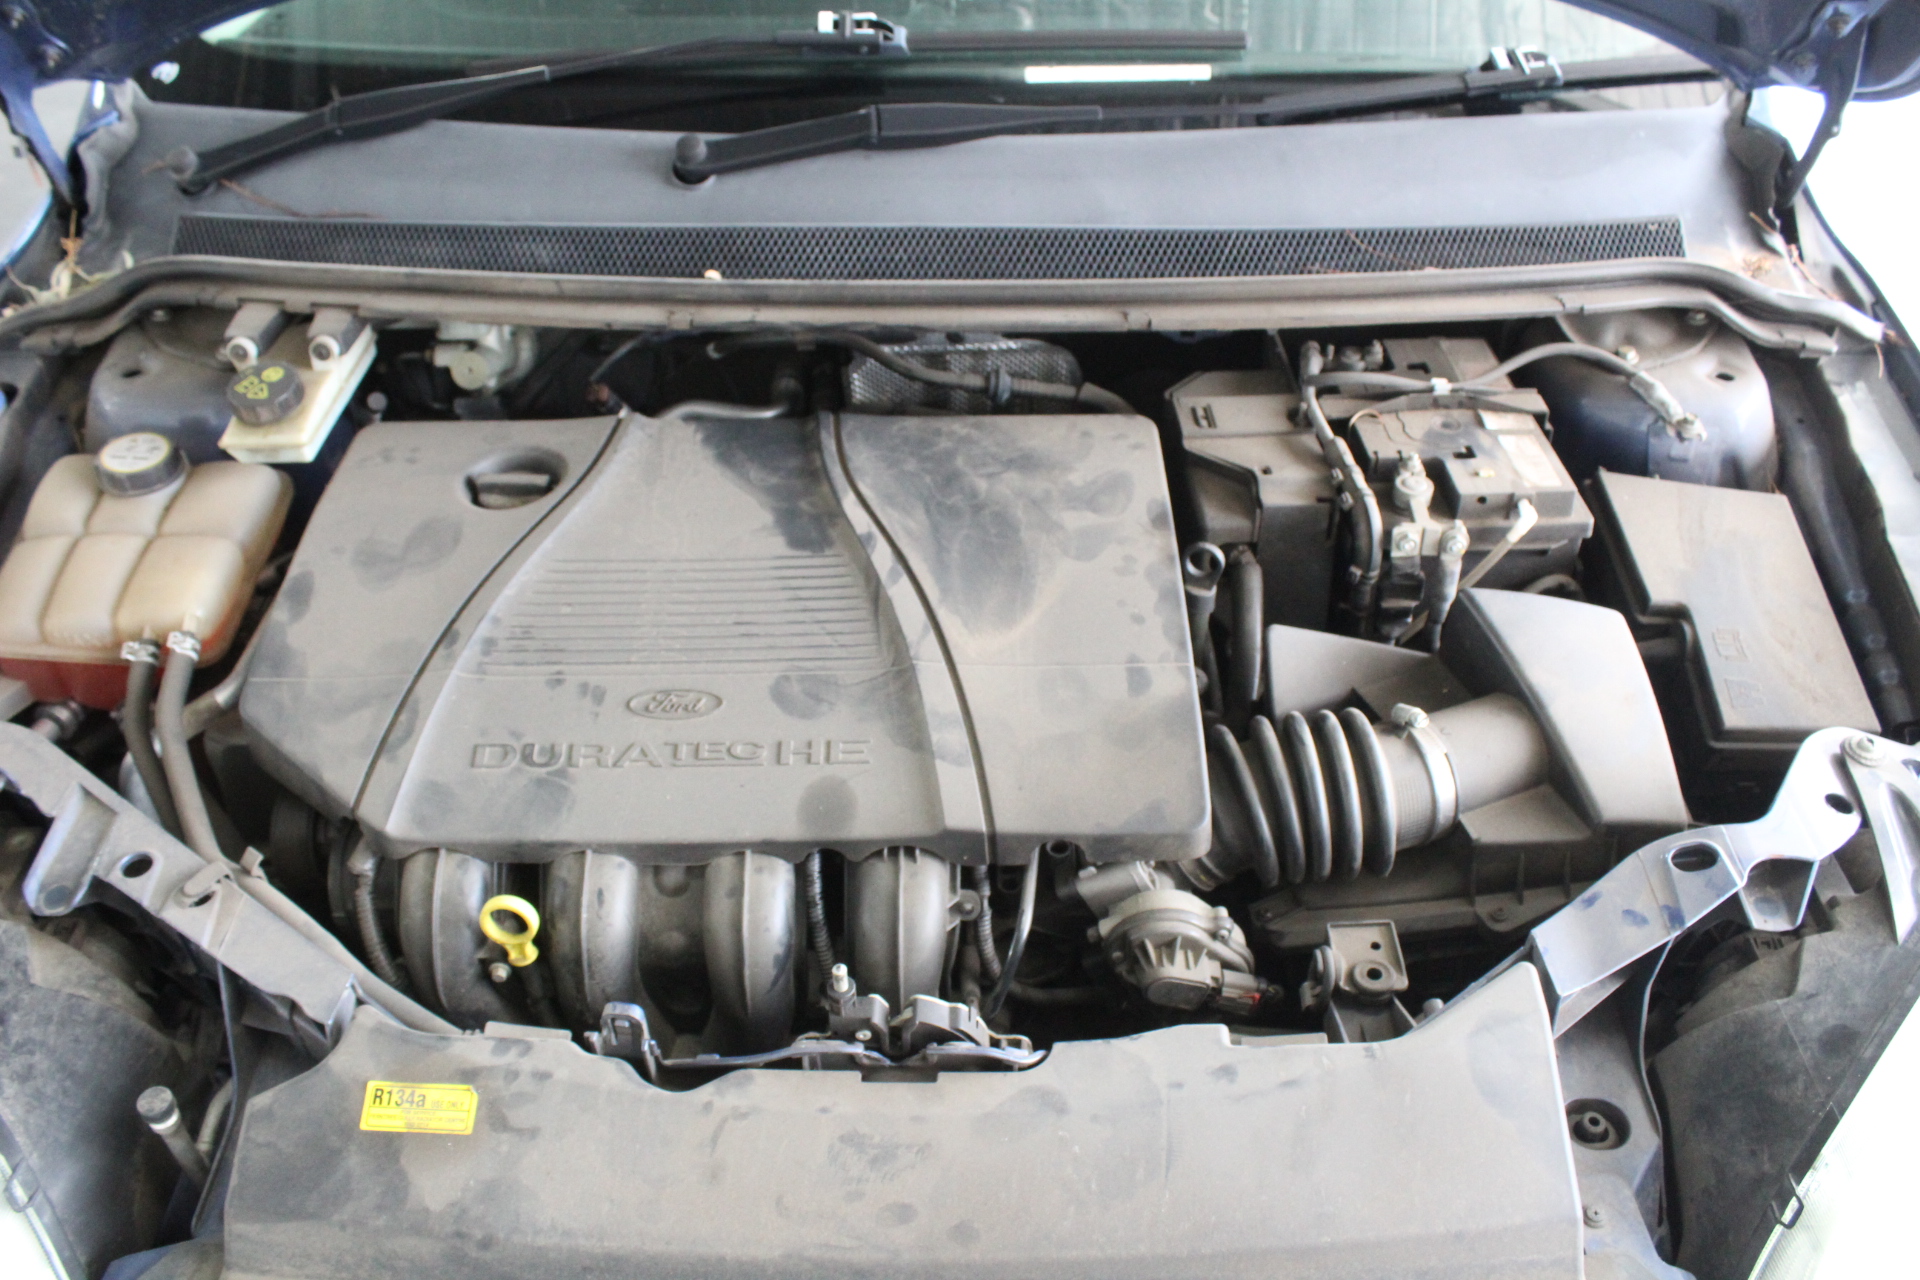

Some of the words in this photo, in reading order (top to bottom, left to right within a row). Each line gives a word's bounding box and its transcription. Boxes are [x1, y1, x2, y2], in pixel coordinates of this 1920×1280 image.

[644, 690, 705, 715] Ford
[372, 1088, 426, 1108] R134a
[430, 1100, 445, 1109] USE
[446, 1100, 465, 1110] ONLY
